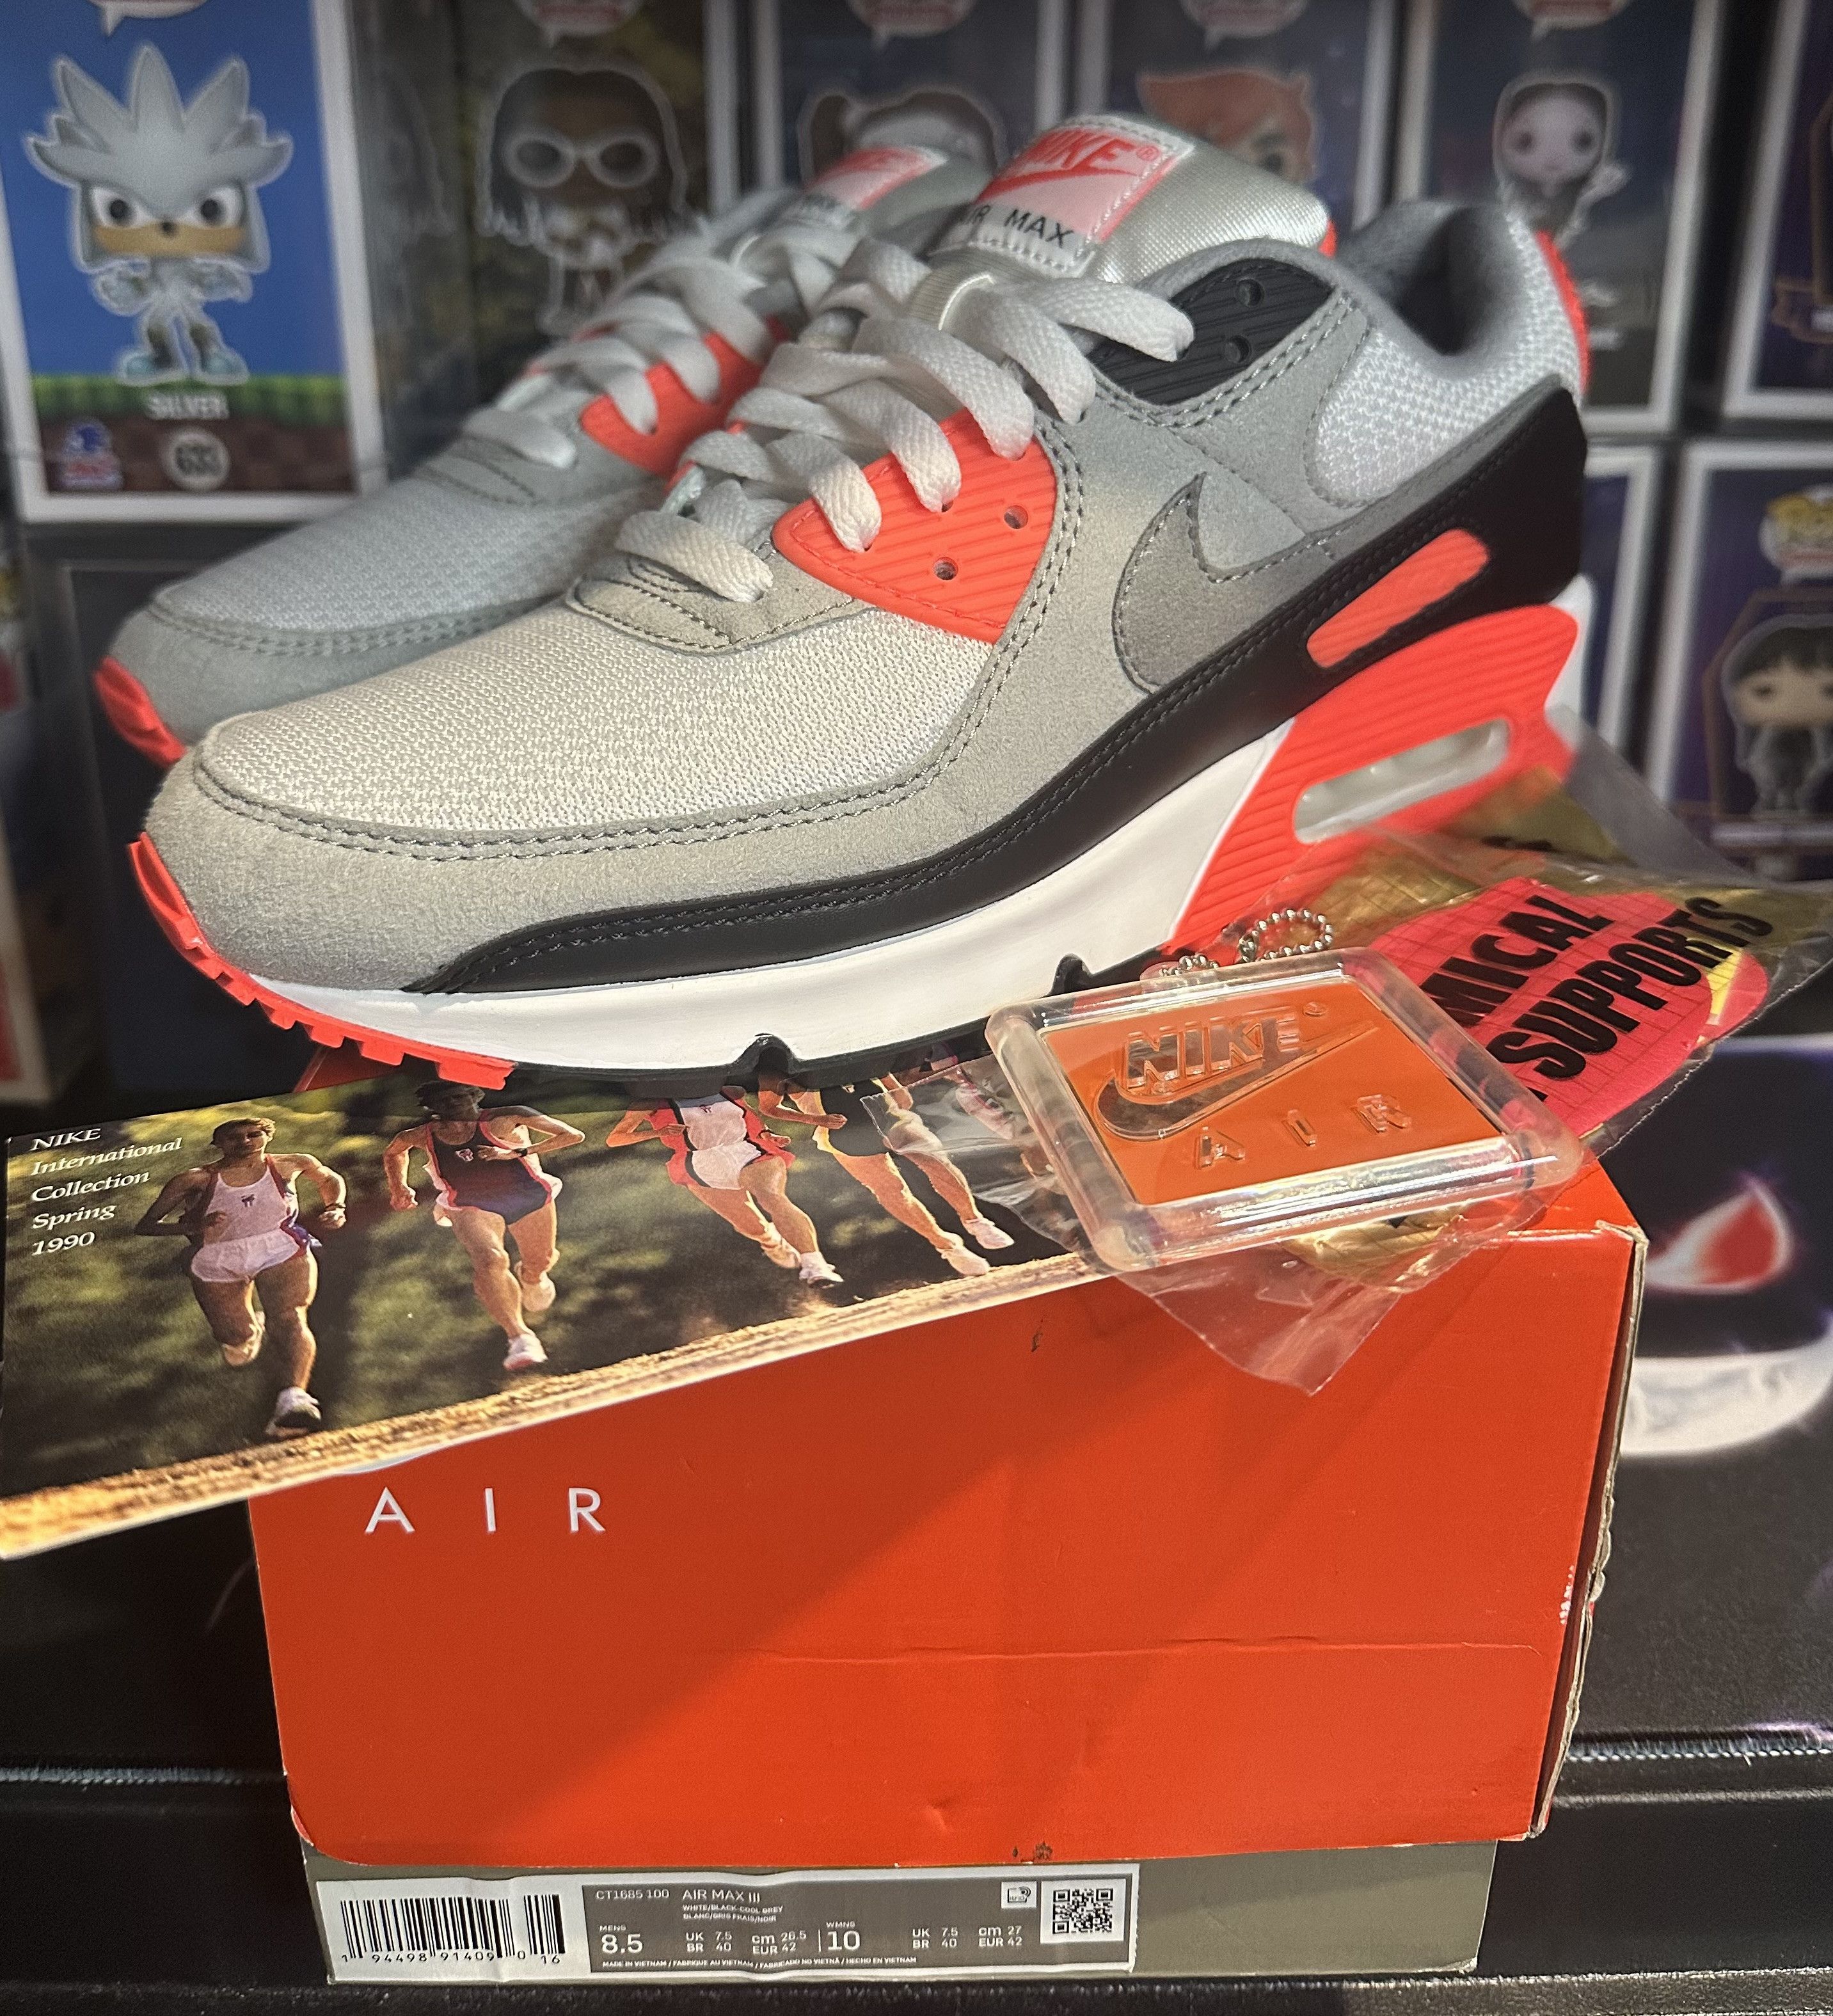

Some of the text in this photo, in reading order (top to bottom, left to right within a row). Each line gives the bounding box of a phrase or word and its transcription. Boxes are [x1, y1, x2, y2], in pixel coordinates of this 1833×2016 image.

[1004, 209, 1074, 249] MAX
[1486, 896, 1773, 1079] SUPPORTS
[1124, 1007, 1301, 1090] NIKE
[30, 1128, 101, 1151] NIKE
[31, 1138, 182, 1175] International
[32, 1171, 150, 1202] Collection
[32, 1205, 117, 1230] Spring
[32, 1232, 95, 1255] 1990
[365, 1486, 606, 1533] AIR
[596, 1889, 670, 1900] CT1685 100
[682, 1889, 761, 1903] AIR MAX III
[686, 1931, 807, 1944] UK 7.5 cm 26.5
[828, 1932, 861, 1951] 10
[912, 1926, 1022, 1938] UK 7.5 cm 27
[913, 1937, 1022, 1948] BR 40 EUR 42
[601, 1933, 643, 1954] 8.5
[686, 1942, 797, 1955] BR 40 EUR 42
[372, 1953, 427, 1962] 94498
[441, 1952, 495, 1962] 91409
[517, 1950, 525, 1960] 0
[541, 1954, 560, 1964] 16
